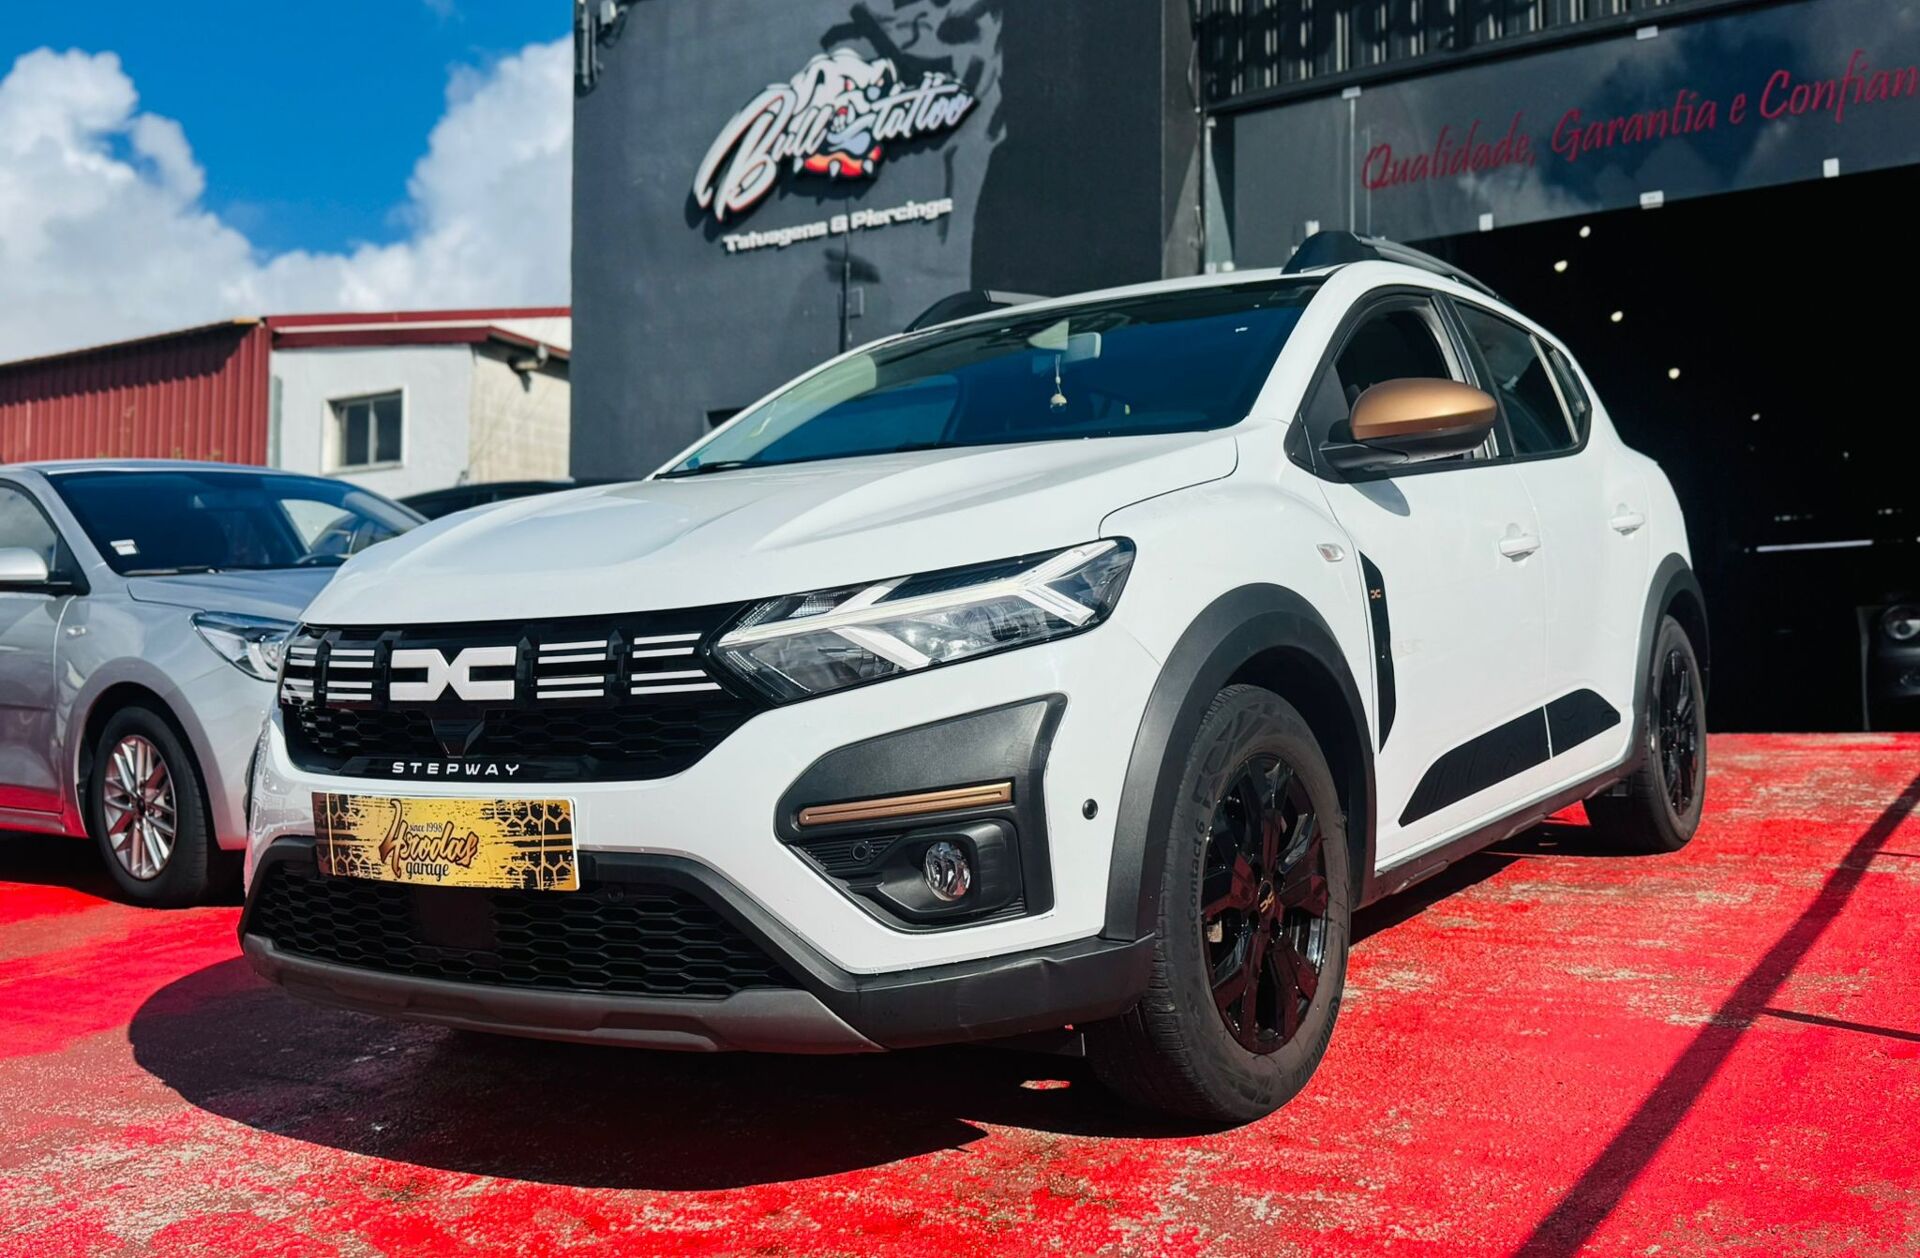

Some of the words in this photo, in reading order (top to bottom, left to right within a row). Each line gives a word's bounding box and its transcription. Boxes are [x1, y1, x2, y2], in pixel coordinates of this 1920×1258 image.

[1360, 111, 1537, 191] Qualidade,
[1550, 87, 1718, 163] Garantia
[1729, 92, 1746, 125] e
[1758, 48, 1920, 124] Confian
[693, 82, 834, 222] Bull
[870, 70, 975, 141] tattoo
[722, 220, 828, 252] Tatuagens
[851, 197, 954, 229] Piercings
[391, 761, 520, 777] STEPWAY
[426, 822, 443, 833] 1998
[405, 861, 450, 882] garage
